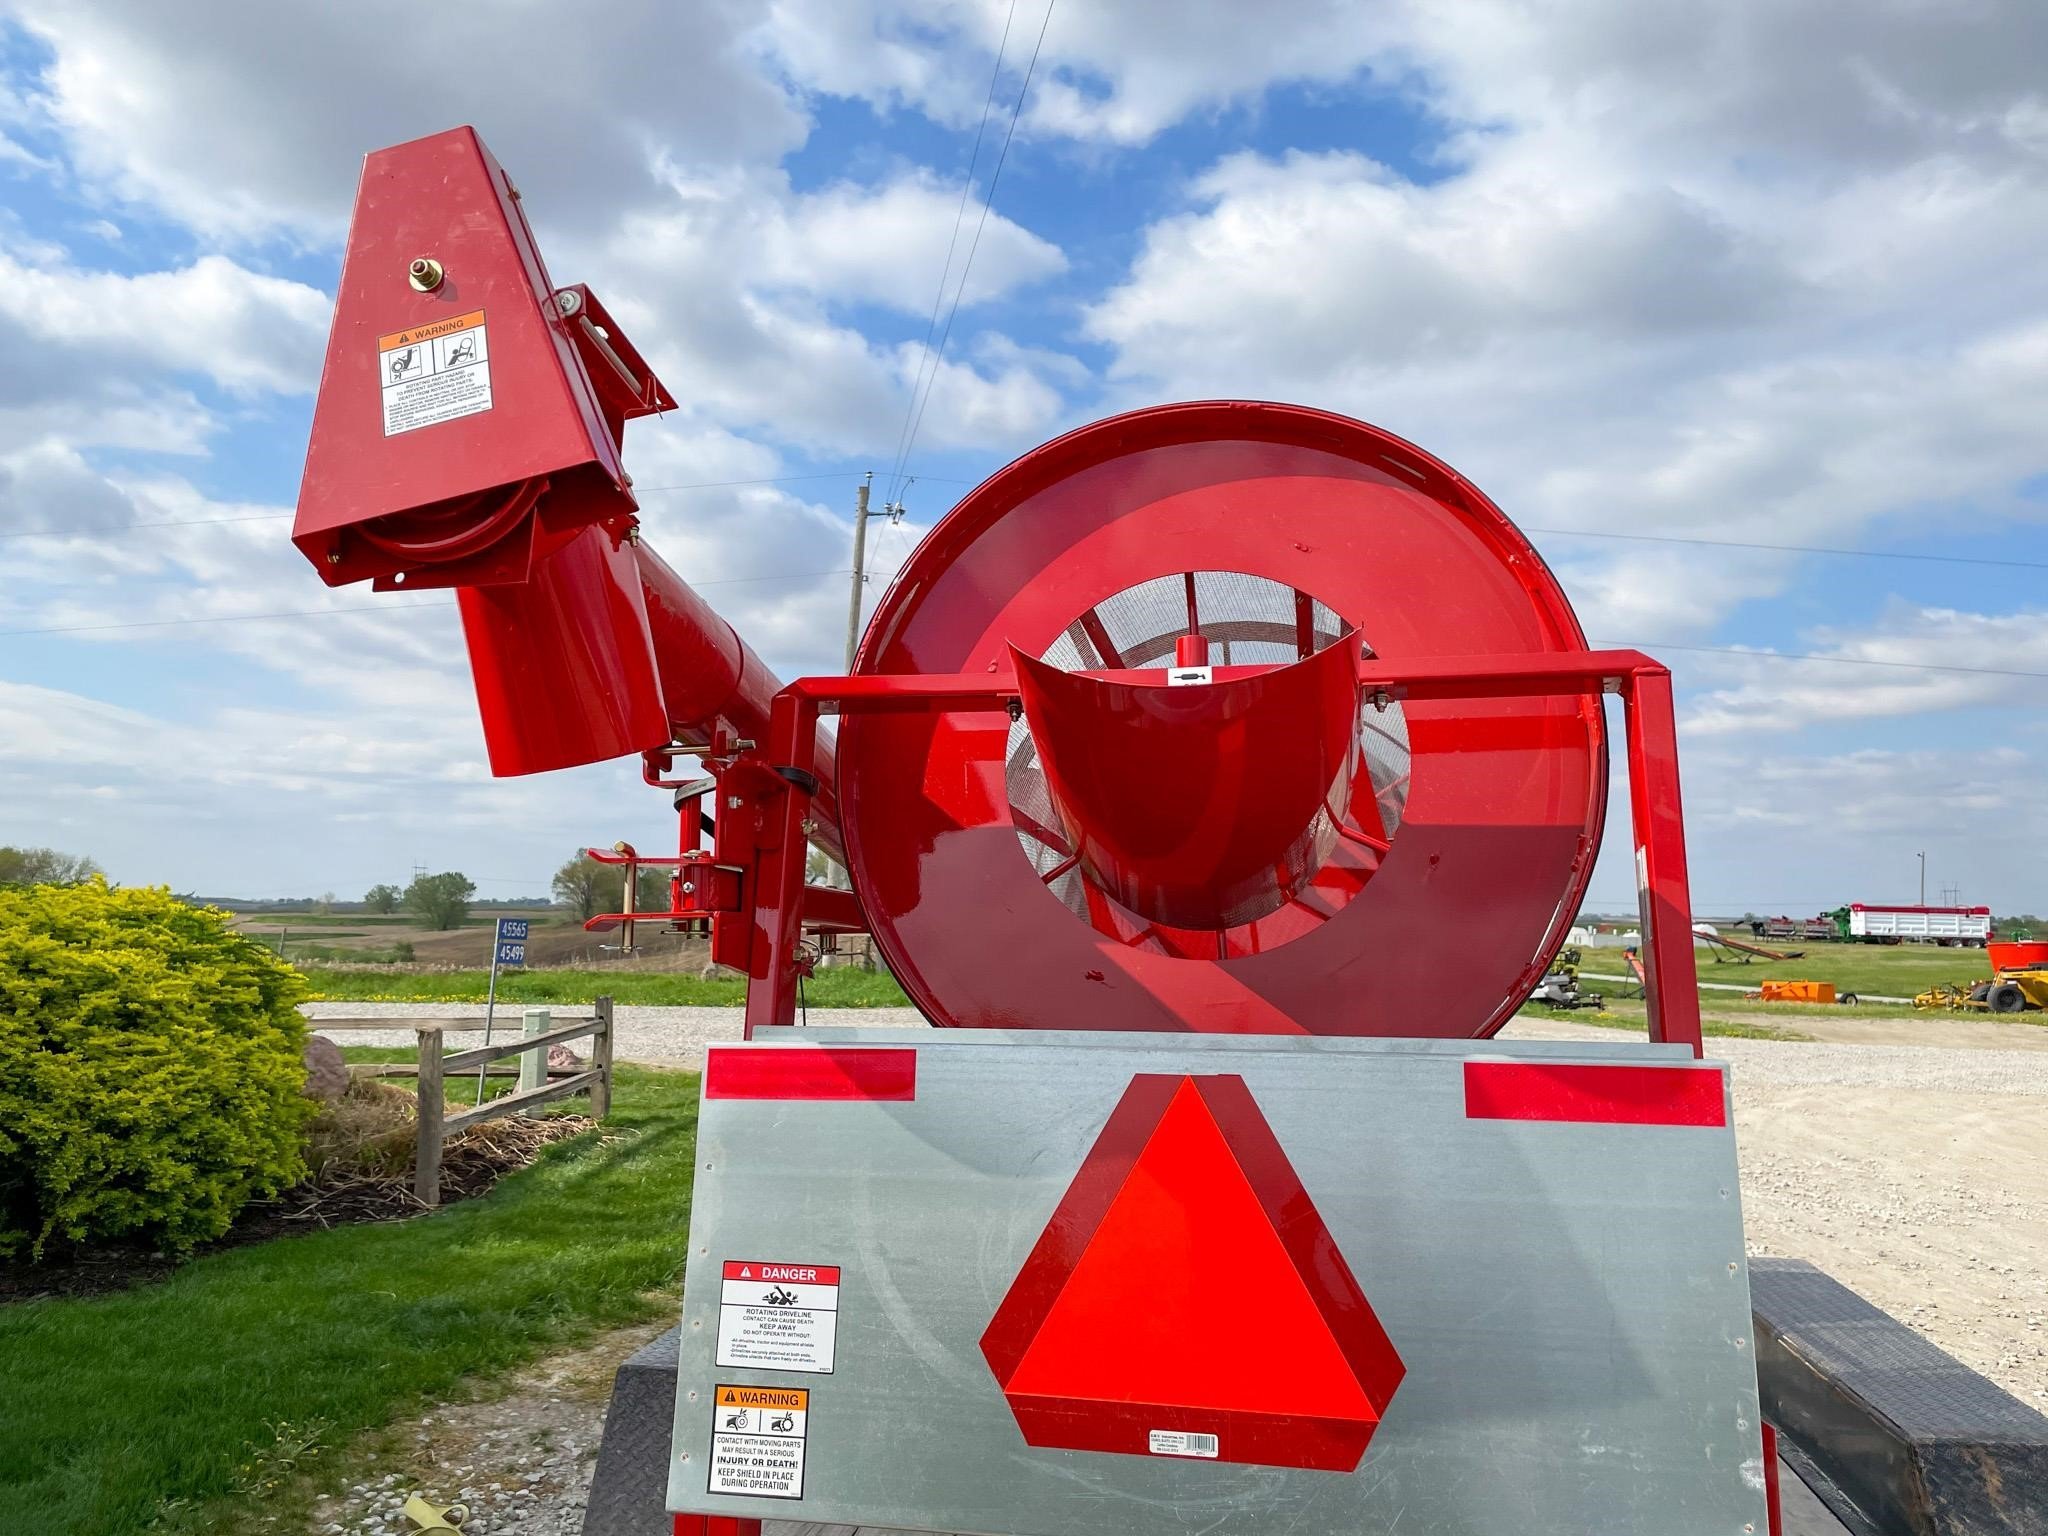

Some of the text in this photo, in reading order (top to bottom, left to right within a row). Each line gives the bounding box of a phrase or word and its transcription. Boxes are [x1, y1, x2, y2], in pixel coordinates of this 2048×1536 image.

[415, 320, 464, 339] WARNING
[502, 922, 527, 937] 45565
[500, 945, 524, 960] 45499
[762, 1267, 816, 1281] DANGER
[740, 1392, 799, 1406] WARNING
[717, 1456, 749, 1464] INJURY
[767, 1459, 798, 1469] DEATH!
[718, 1468, 735, 1476] KEEP
[737, 1469, 761, 1478] SHIELD
[772, 1472, 794, 1480] PLACE
[722, 1478, 789, 1490] DURING OPERATION
